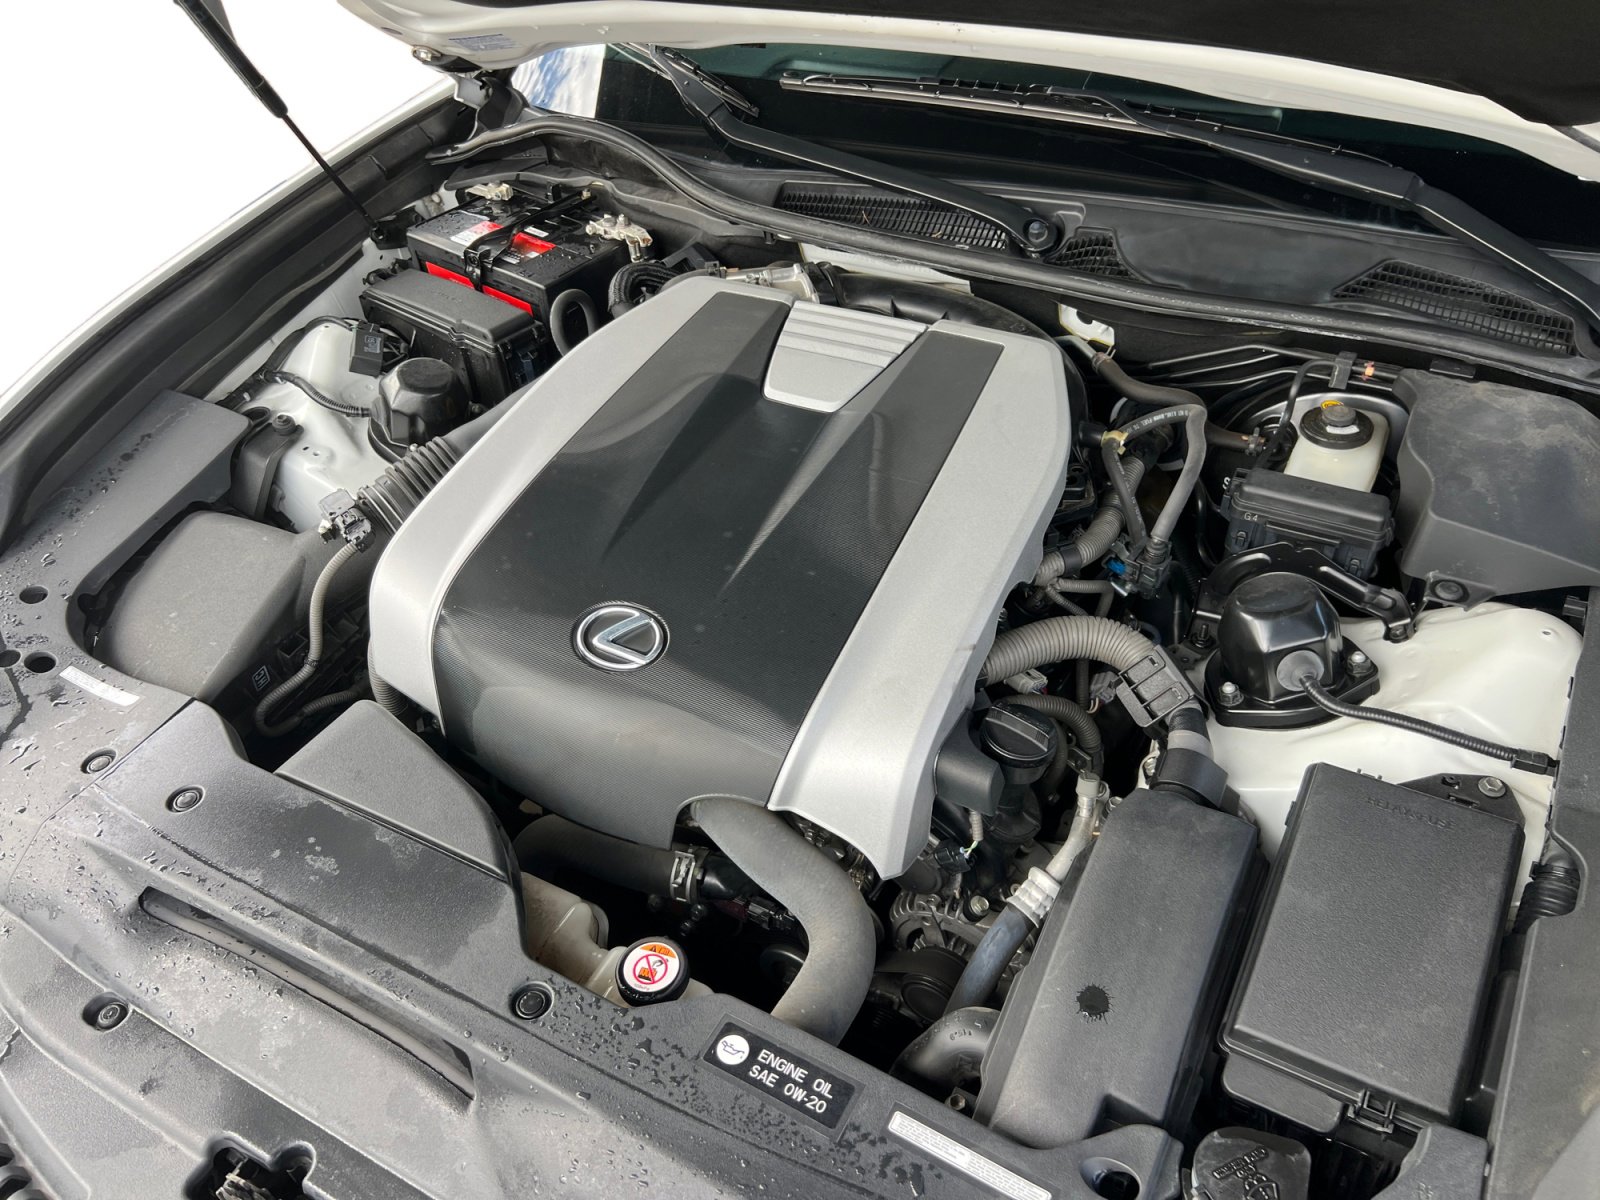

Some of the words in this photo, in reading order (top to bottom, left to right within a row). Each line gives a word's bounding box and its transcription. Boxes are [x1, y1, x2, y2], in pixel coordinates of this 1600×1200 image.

[749, 1065, 780, 1088] SAE
[783, 1083, 827, 1113] 0W-20
[757, 1049, 809, 1083] ENGINE
[813, 1078, 833, 1099] OIL
